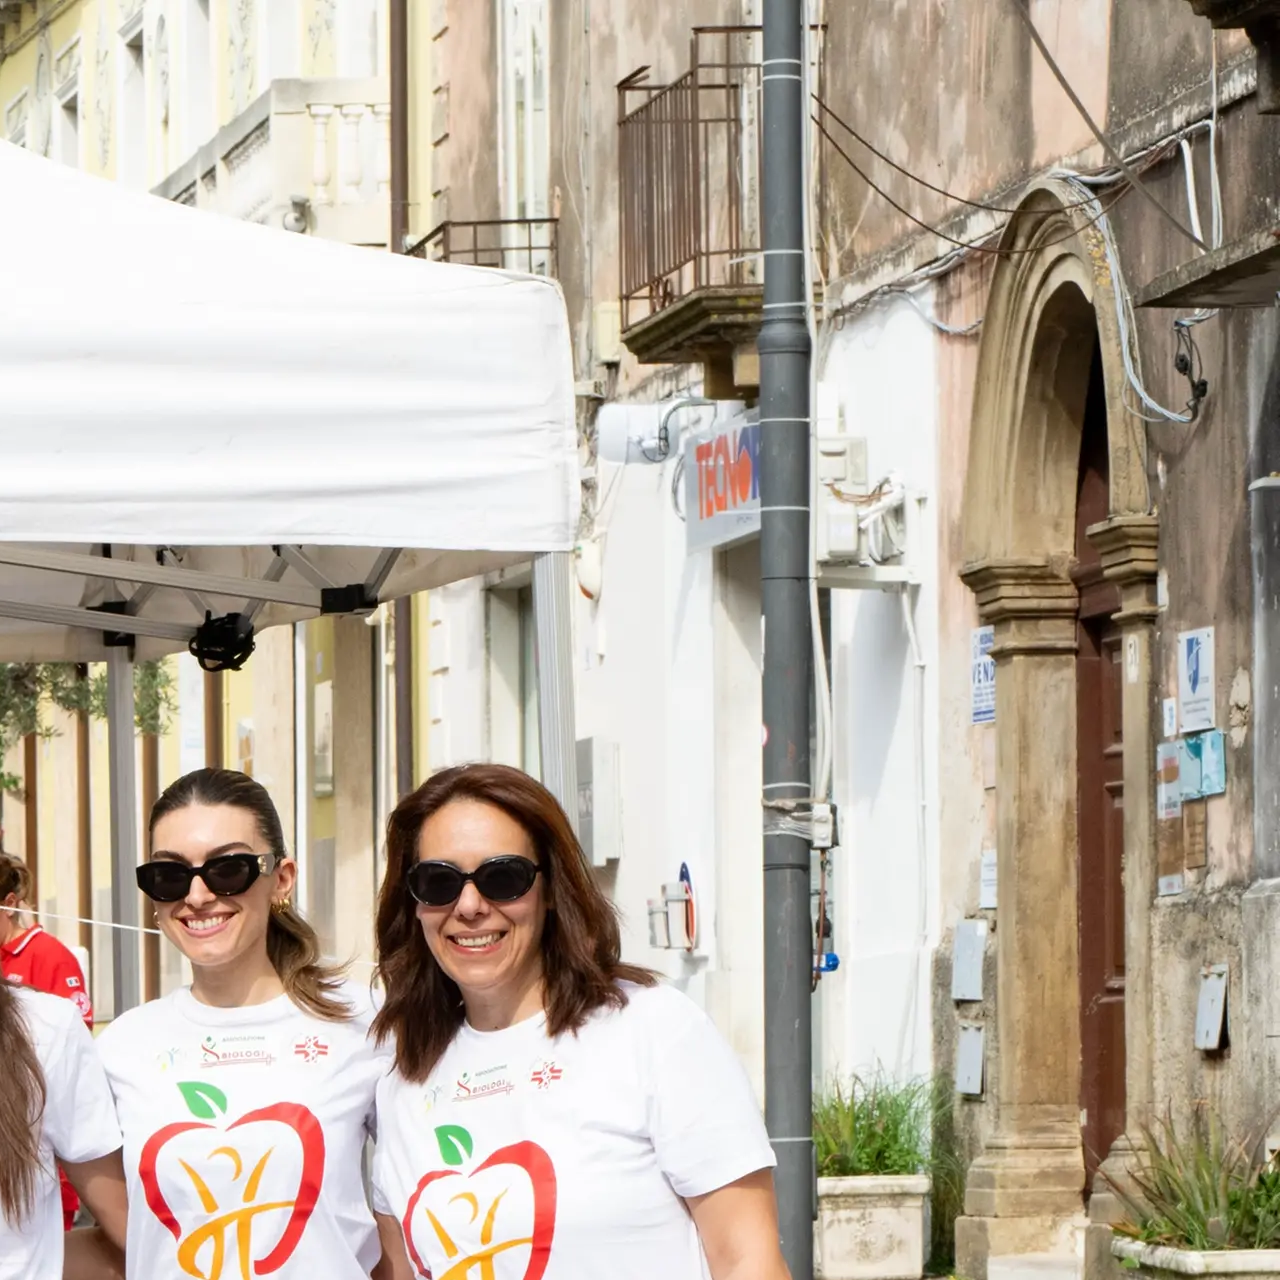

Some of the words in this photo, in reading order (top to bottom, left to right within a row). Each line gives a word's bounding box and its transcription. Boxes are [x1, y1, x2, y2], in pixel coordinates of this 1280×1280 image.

[972, 661, 995, 684] VEND
[221, 1050, 265, 1059] BIOLOGI
[472, 1080, 506, 1094] BIOLOGI
